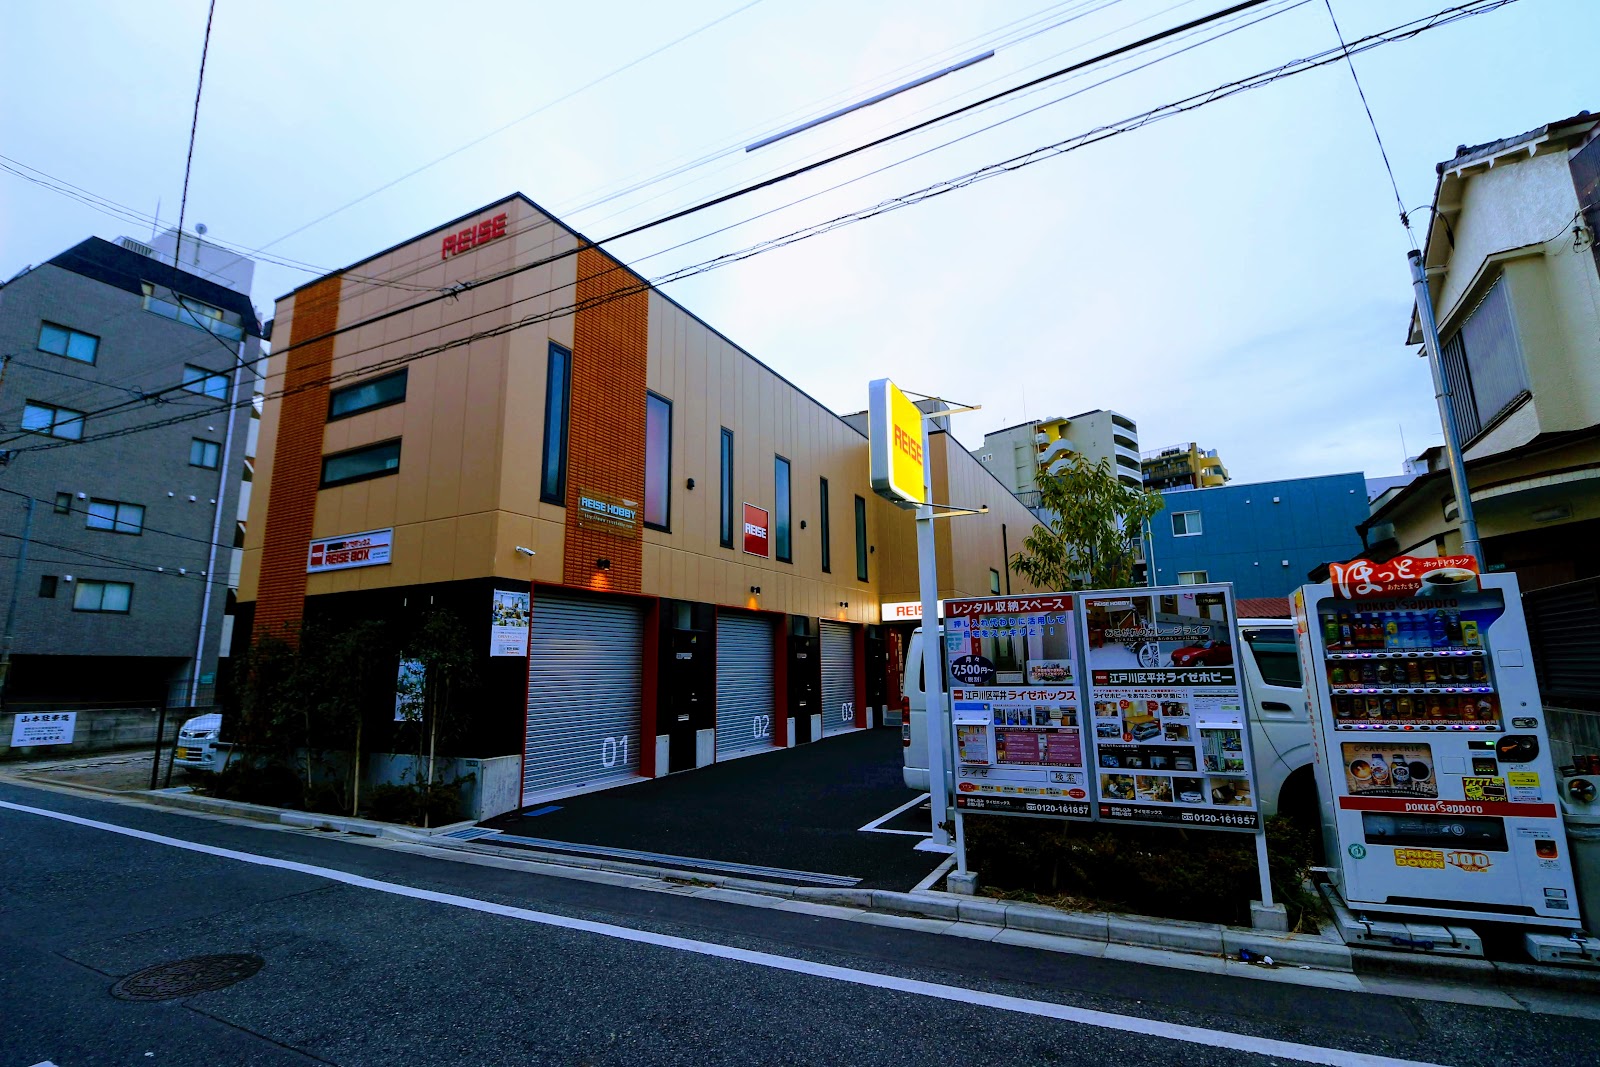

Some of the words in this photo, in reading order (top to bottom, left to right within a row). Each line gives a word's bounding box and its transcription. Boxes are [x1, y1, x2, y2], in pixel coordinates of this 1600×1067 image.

[442, 212, 508, 260] REISE
[894, 424, 922, 466] REISE
[581, 496, 606, 512] REISE
[607, 503, 636, 520] HOBBY
[745, 522, 767, 540] REISE
[325, 552, 350, 565] REISE
[351, 549, 370, 562] BOX
[1422, 557, 1470, 568] ホットドリンク
[1334, 559, 1416, 600] ほっと
[1387, 583, 1420, 591] あたたまる
[953, 599, 1065, 615] レンタル収納スペース
[954, 615, 1067, 629] 押し入れ代わりに活用して
[1109, 672, 1232, 684] 江戸川区平井ライゼホビー
[965, 690, 1077, 701] 江戸川区平井ライゼボックス
[841, 702, 853, 722] 03
[753, 715, 770, 739] 02
[602, 735, 629, 768] 01
[961, 769, 989, 778] ライゼ
[1055, 773, 1076, 782] 検索
[1463, 778, 1490, 786] 7777
[1036, 804, 1090, 815] 0120-161857
[1194, 813, 1256, 826] 0120-161857
[1394, 848, 1444, 860] PRICE
[1448, 851, 1490, 867] 100
[1396, 858, 1446, 869] DOWN
